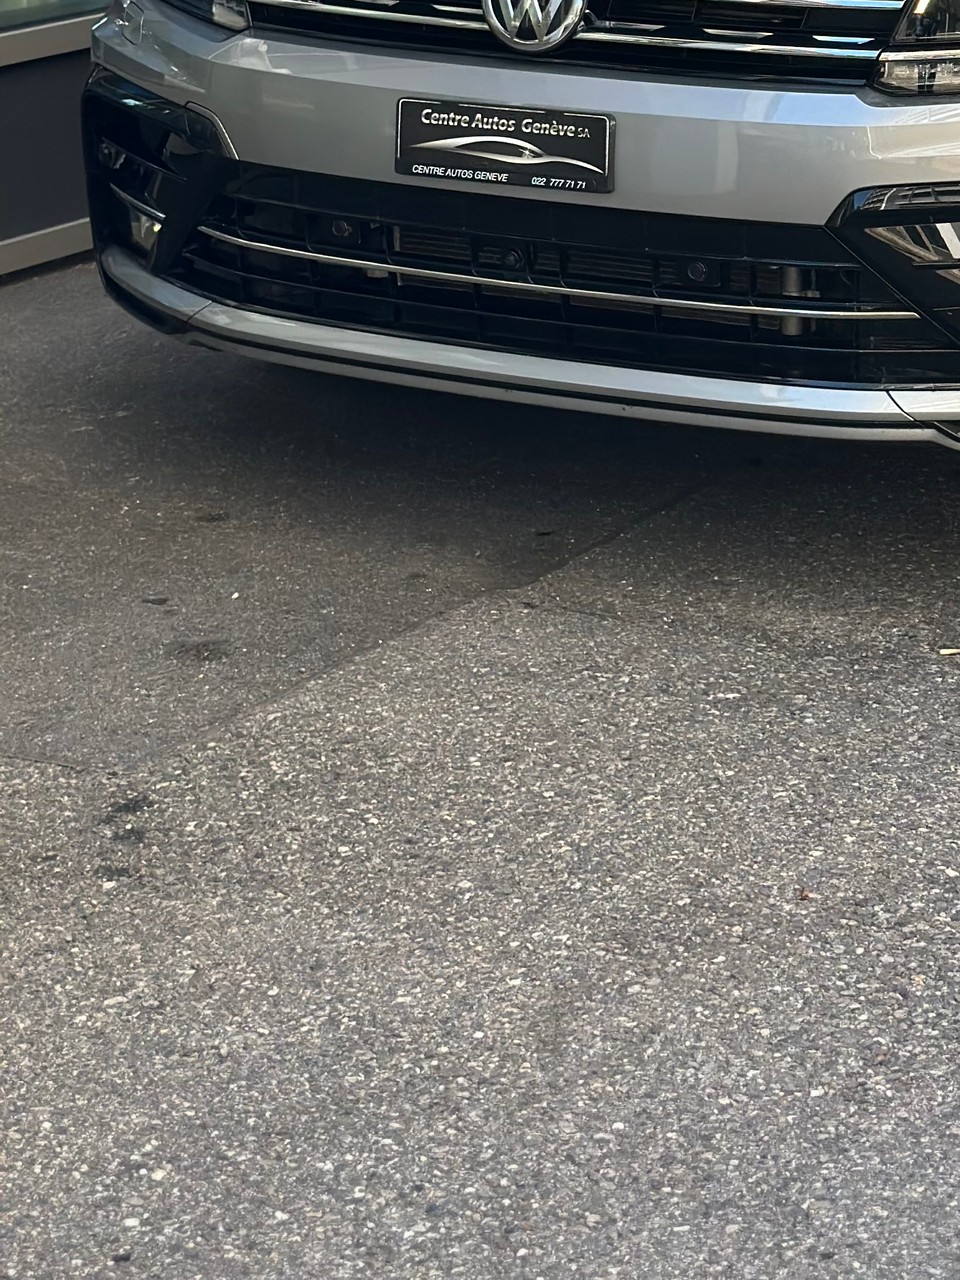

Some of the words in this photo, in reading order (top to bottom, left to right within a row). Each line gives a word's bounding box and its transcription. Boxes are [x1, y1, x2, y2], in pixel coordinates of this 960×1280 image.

[421, 108, 470, 127] Centre
[471, 113, 516, 131] Autos
[521, 118, 576, 137] Genève
[577, 127, 591, 138] SA
[412, 164, 445, 176] CENTRE
[445, 168, 473, 179] AUTOS
[474, 171, 509, 182] GENEVE
[531, 176, 546, 186] 022
[550, 178, 564, 187] 777
[565, 180, 575, 189] 71
[576, 181, 587, 189] 71
